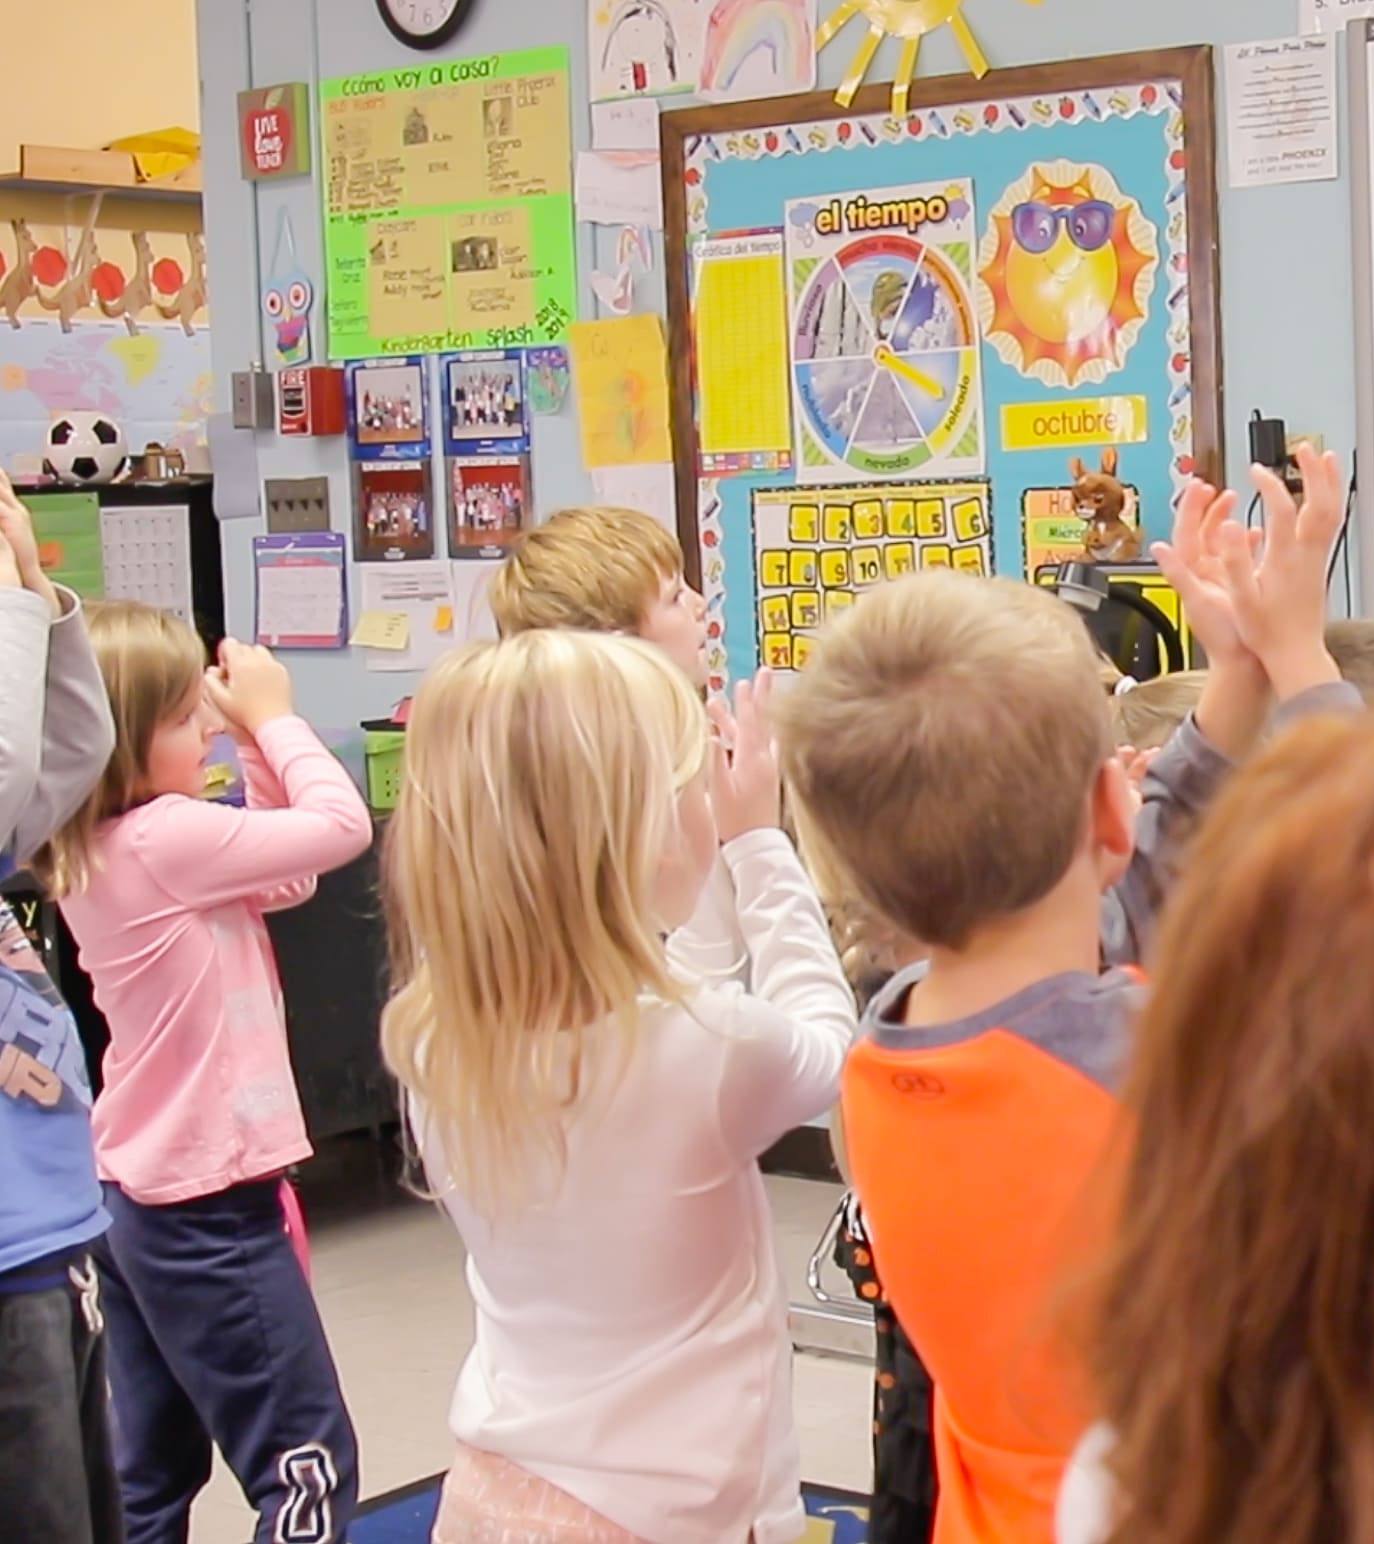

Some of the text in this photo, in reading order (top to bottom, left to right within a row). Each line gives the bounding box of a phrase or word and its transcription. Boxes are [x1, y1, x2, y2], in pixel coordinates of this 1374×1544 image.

[450, 56, 500, 82] casa?
[815, 195, 948, 236] el tiempo
[281, 370, 305, 386] FIRE
[944, 375, 971, 433] soleado
[1033, 409, 1118, 437] octubre
[864, 456, 910, 469] nevado
[808, 513, 980, 539] 1 2 3 4 5 6
[776, 565, 785, 583] 7
[835, 565, 846, 582] 9
[859, 561, 878, 580] 10
[799, 605, 816, 625] 15
[771, 646, 790, 665] 21
